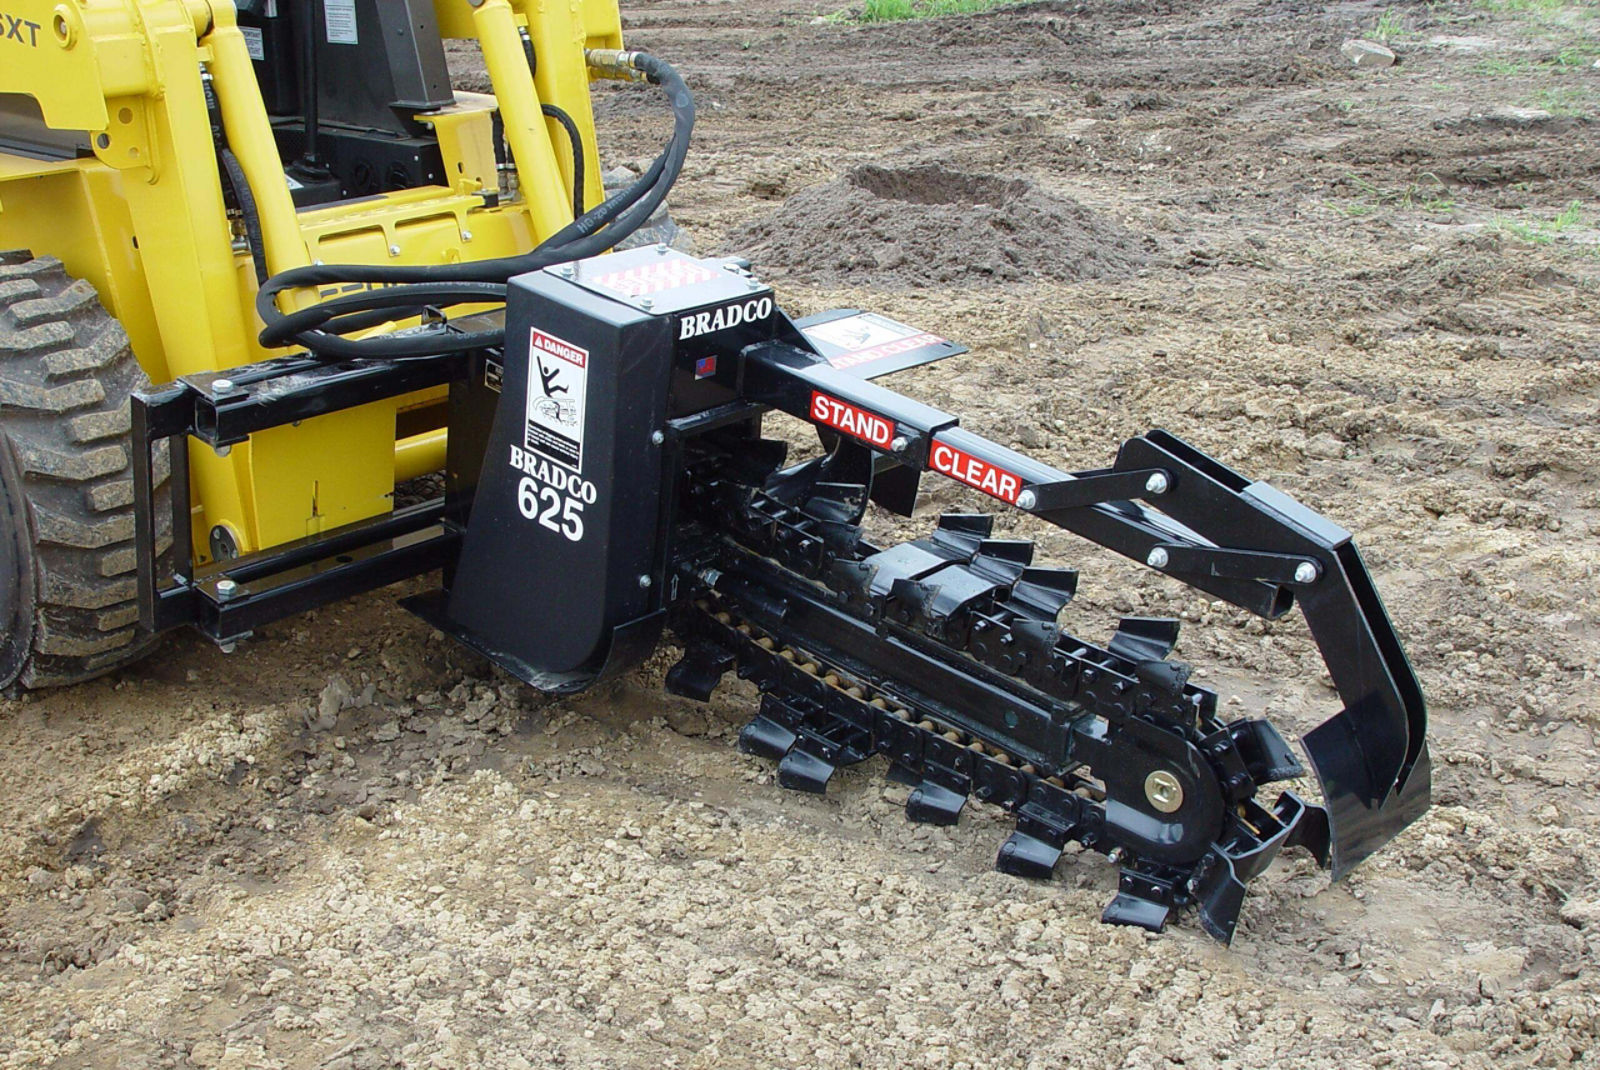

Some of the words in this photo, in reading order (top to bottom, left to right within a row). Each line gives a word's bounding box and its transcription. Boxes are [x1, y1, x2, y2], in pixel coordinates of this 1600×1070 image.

[679, 297, 772, 340] BRADCO
[544, 338, 584, 366] DANGER
[814, 395, 889, 445] STAND
[509, 444, 597, 504] BRADCO
[934, 446, 1017, 501] CLEAR
[518, 476, 585, 542] 625
